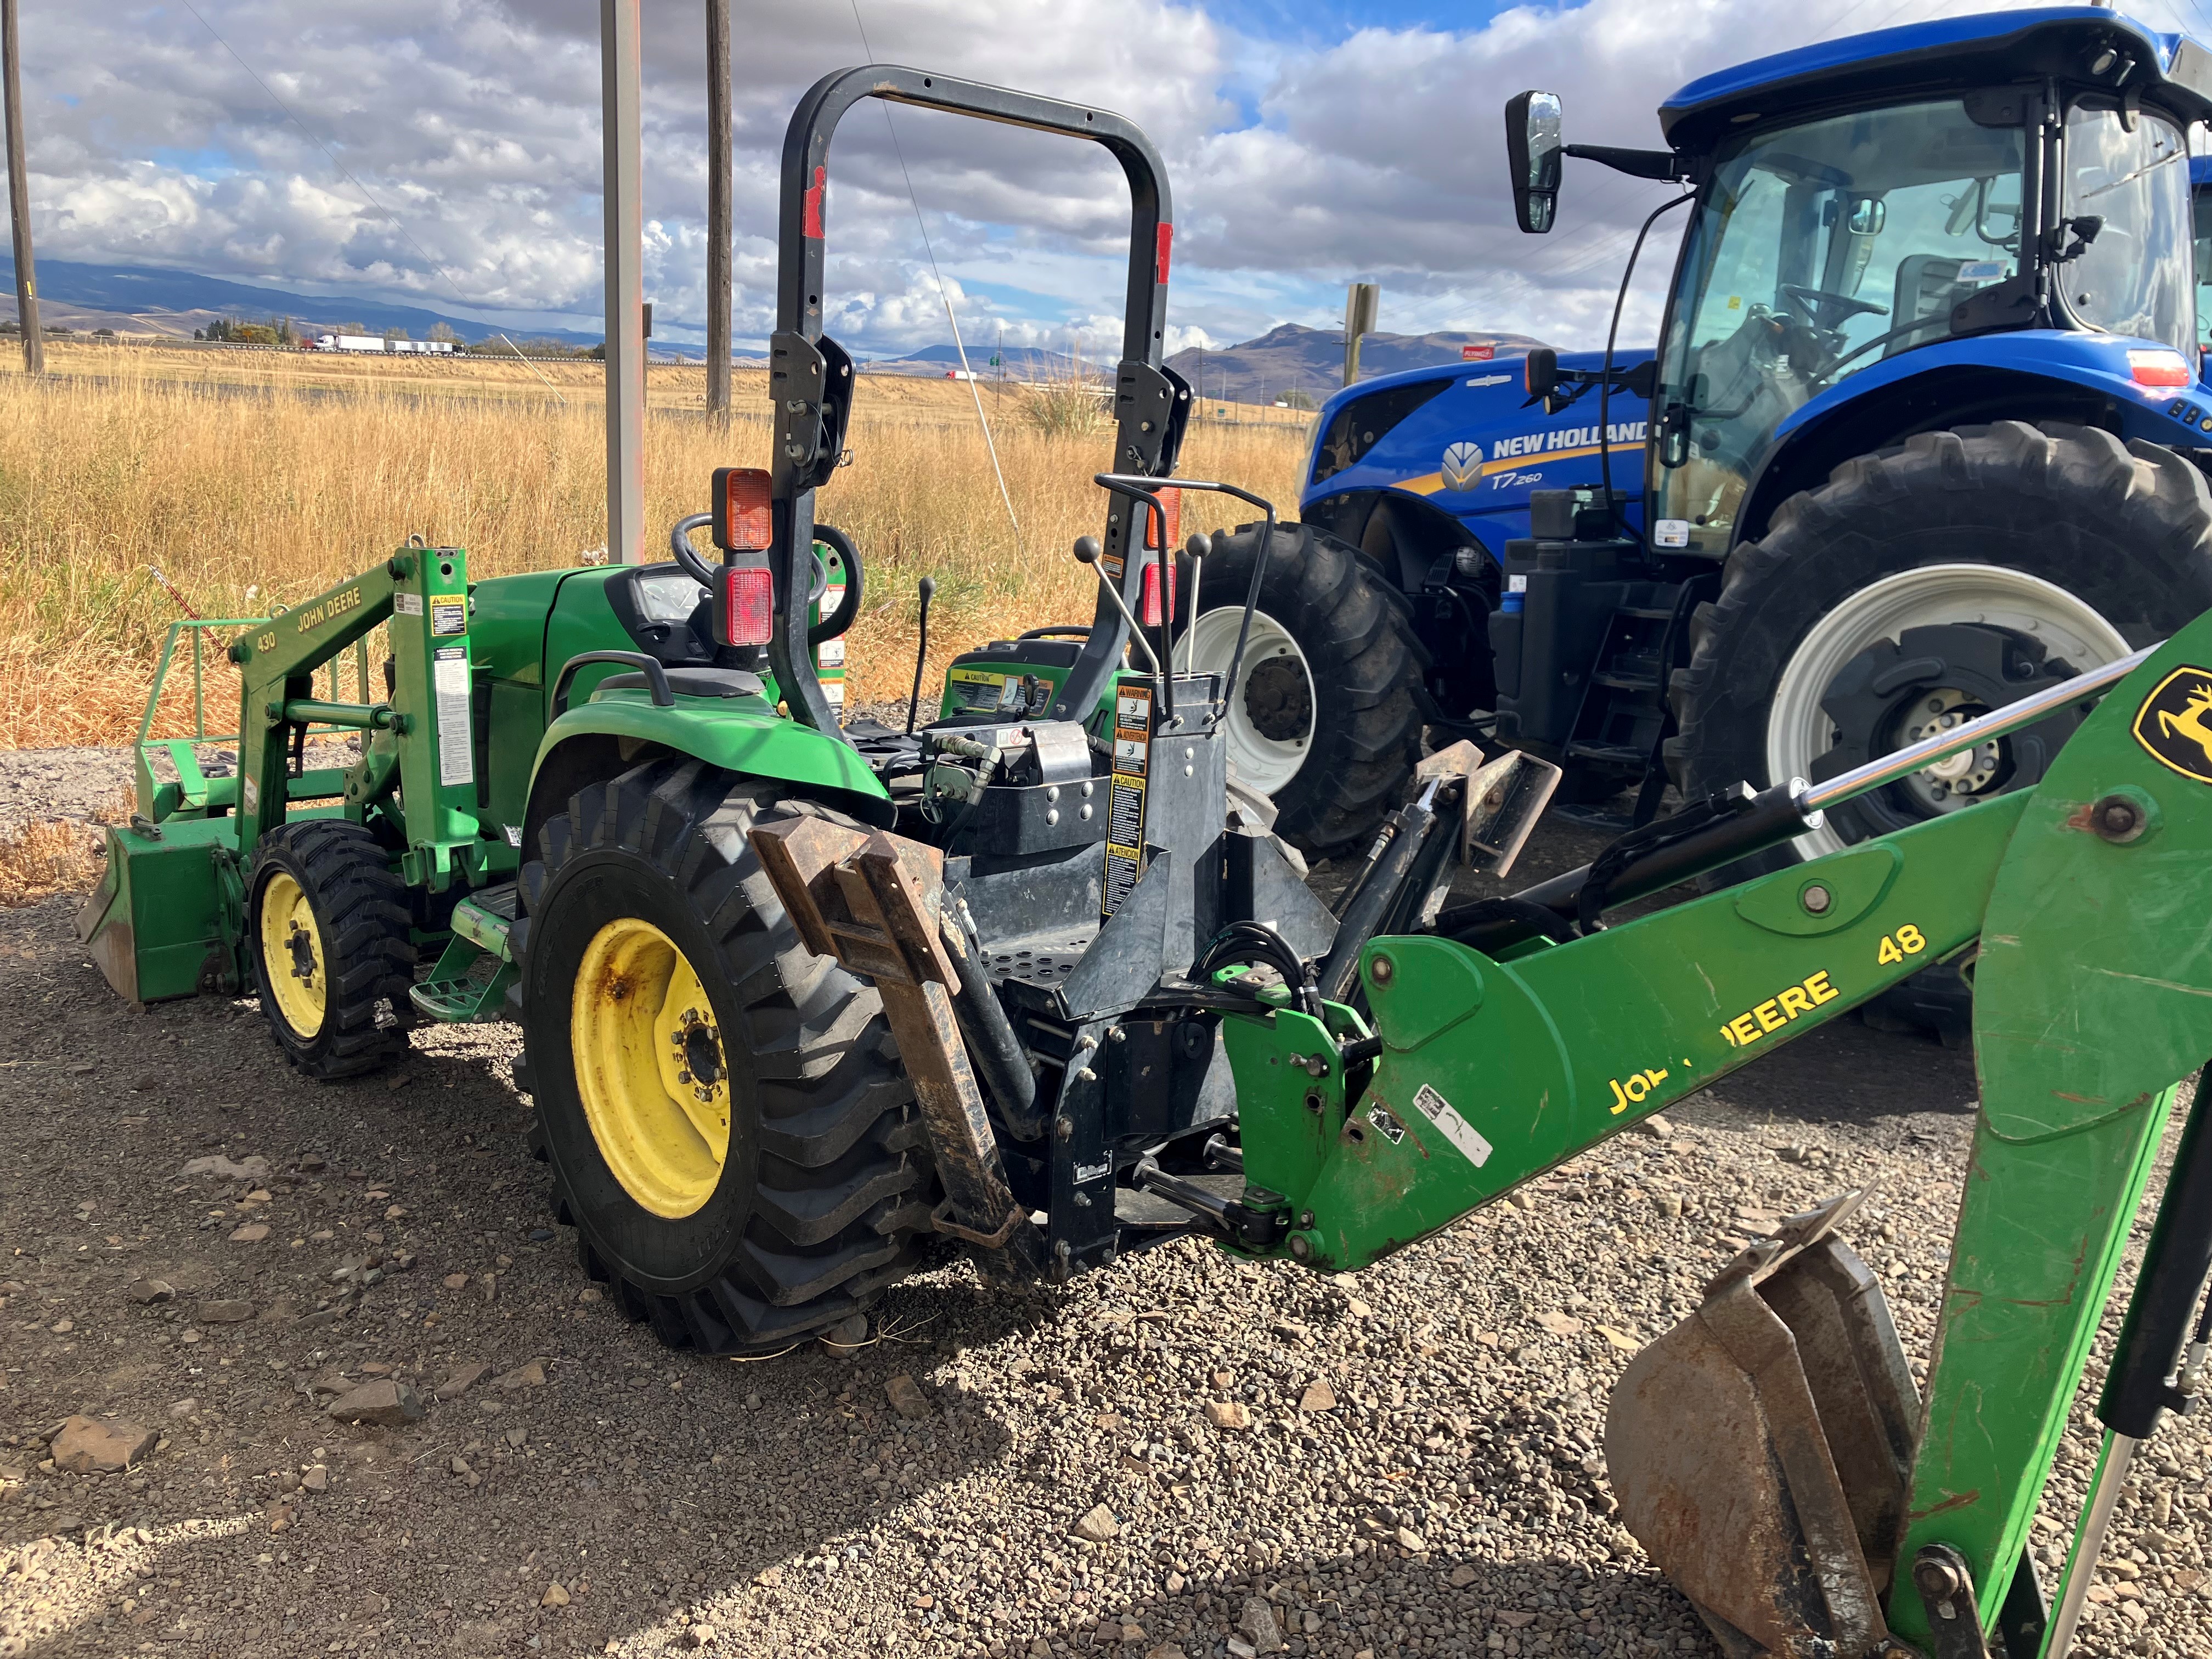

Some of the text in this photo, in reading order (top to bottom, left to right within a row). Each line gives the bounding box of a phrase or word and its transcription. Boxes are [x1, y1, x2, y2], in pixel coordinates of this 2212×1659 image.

[1493, 421, 1648, 459] NEW HOLLAND
[1492, 471, 1543, 490] T7.260
[297, 604, 325, 634] JOHN
[327, 586, 362, 618] DEERE
[257, 631, 276, 653] 430
[970, 674, 989, 682] CAUTION
[1126, 689, 1150, 698] WARNING
[1124, 731, 1147, 741] ADVERTENCIA
[1120, 777, 1144, 788] CAUTION
[1115, 847, 1138, 859] ATENCION
[1877, 923, 1927, 966] 48
